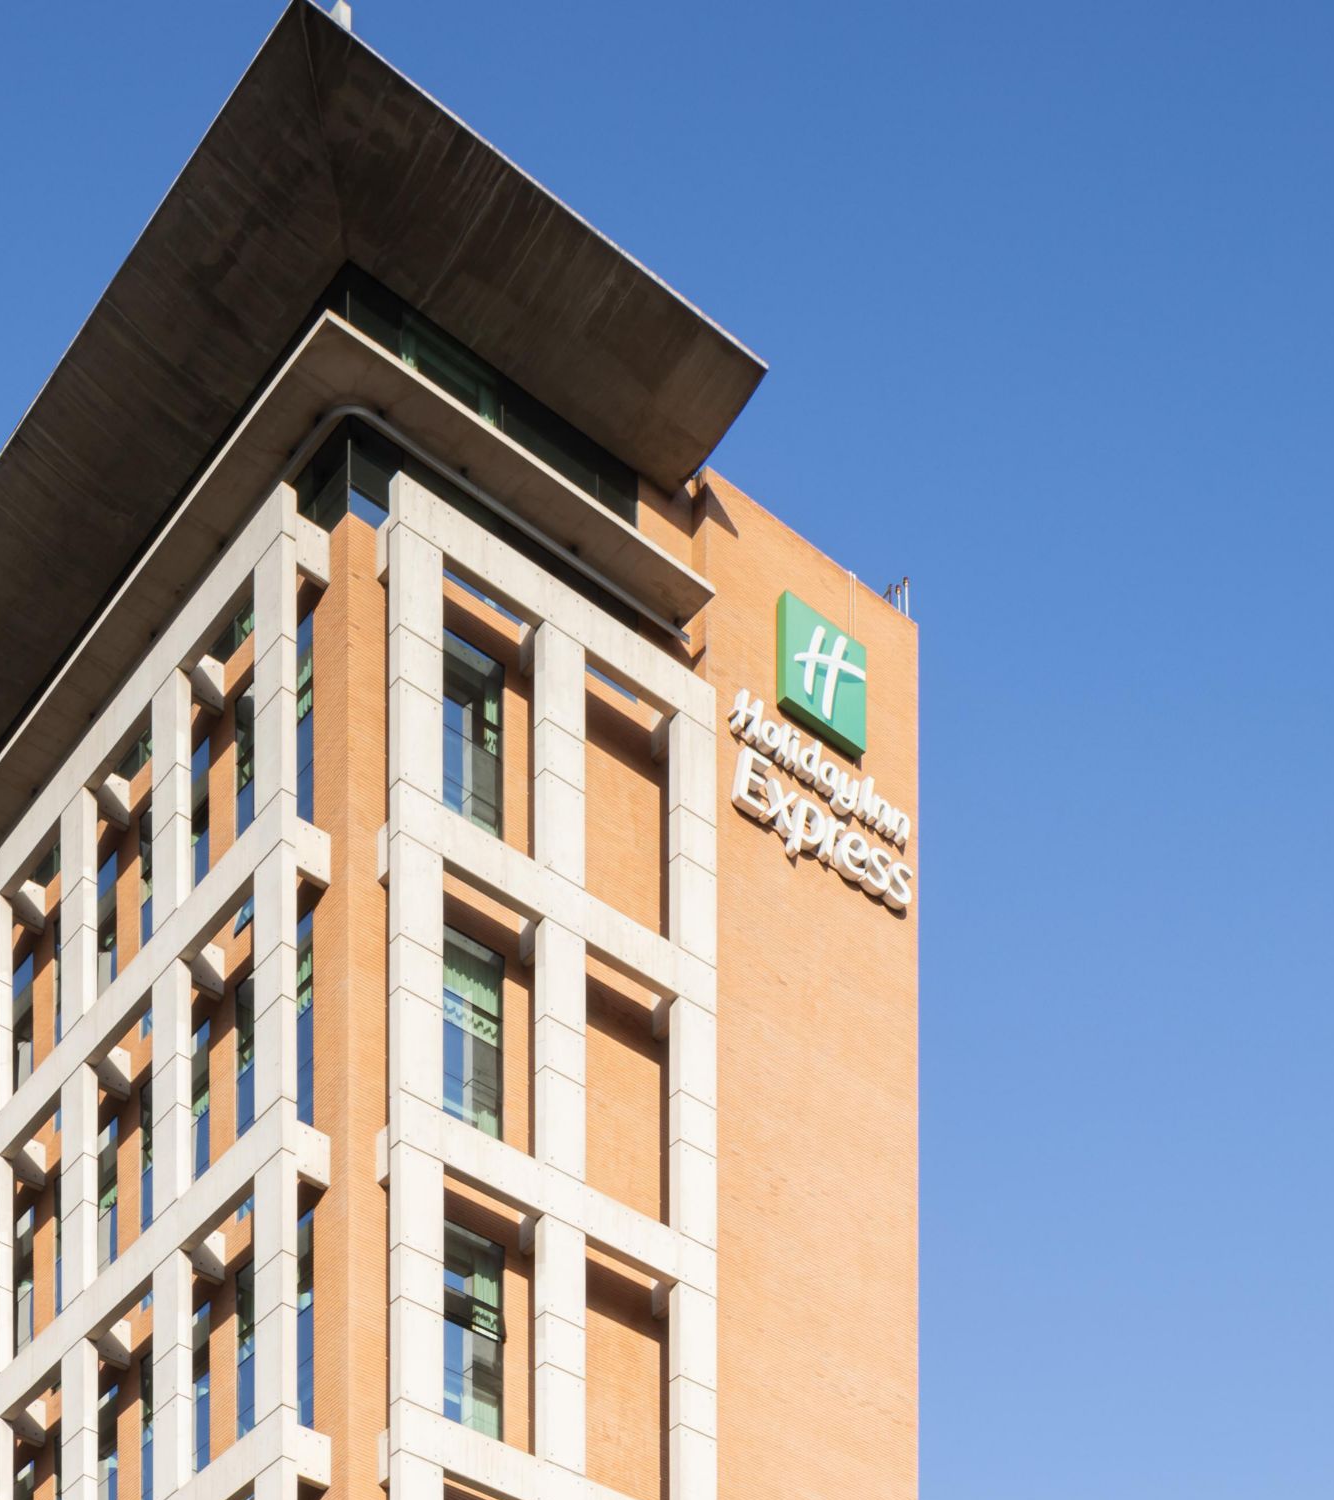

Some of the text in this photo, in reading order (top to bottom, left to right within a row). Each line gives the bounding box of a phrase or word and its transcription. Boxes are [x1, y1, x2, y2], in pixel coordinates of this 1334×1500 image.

[727, 687, 911, 846] Holiday Inn
[731, 746, 914, 911] Express
